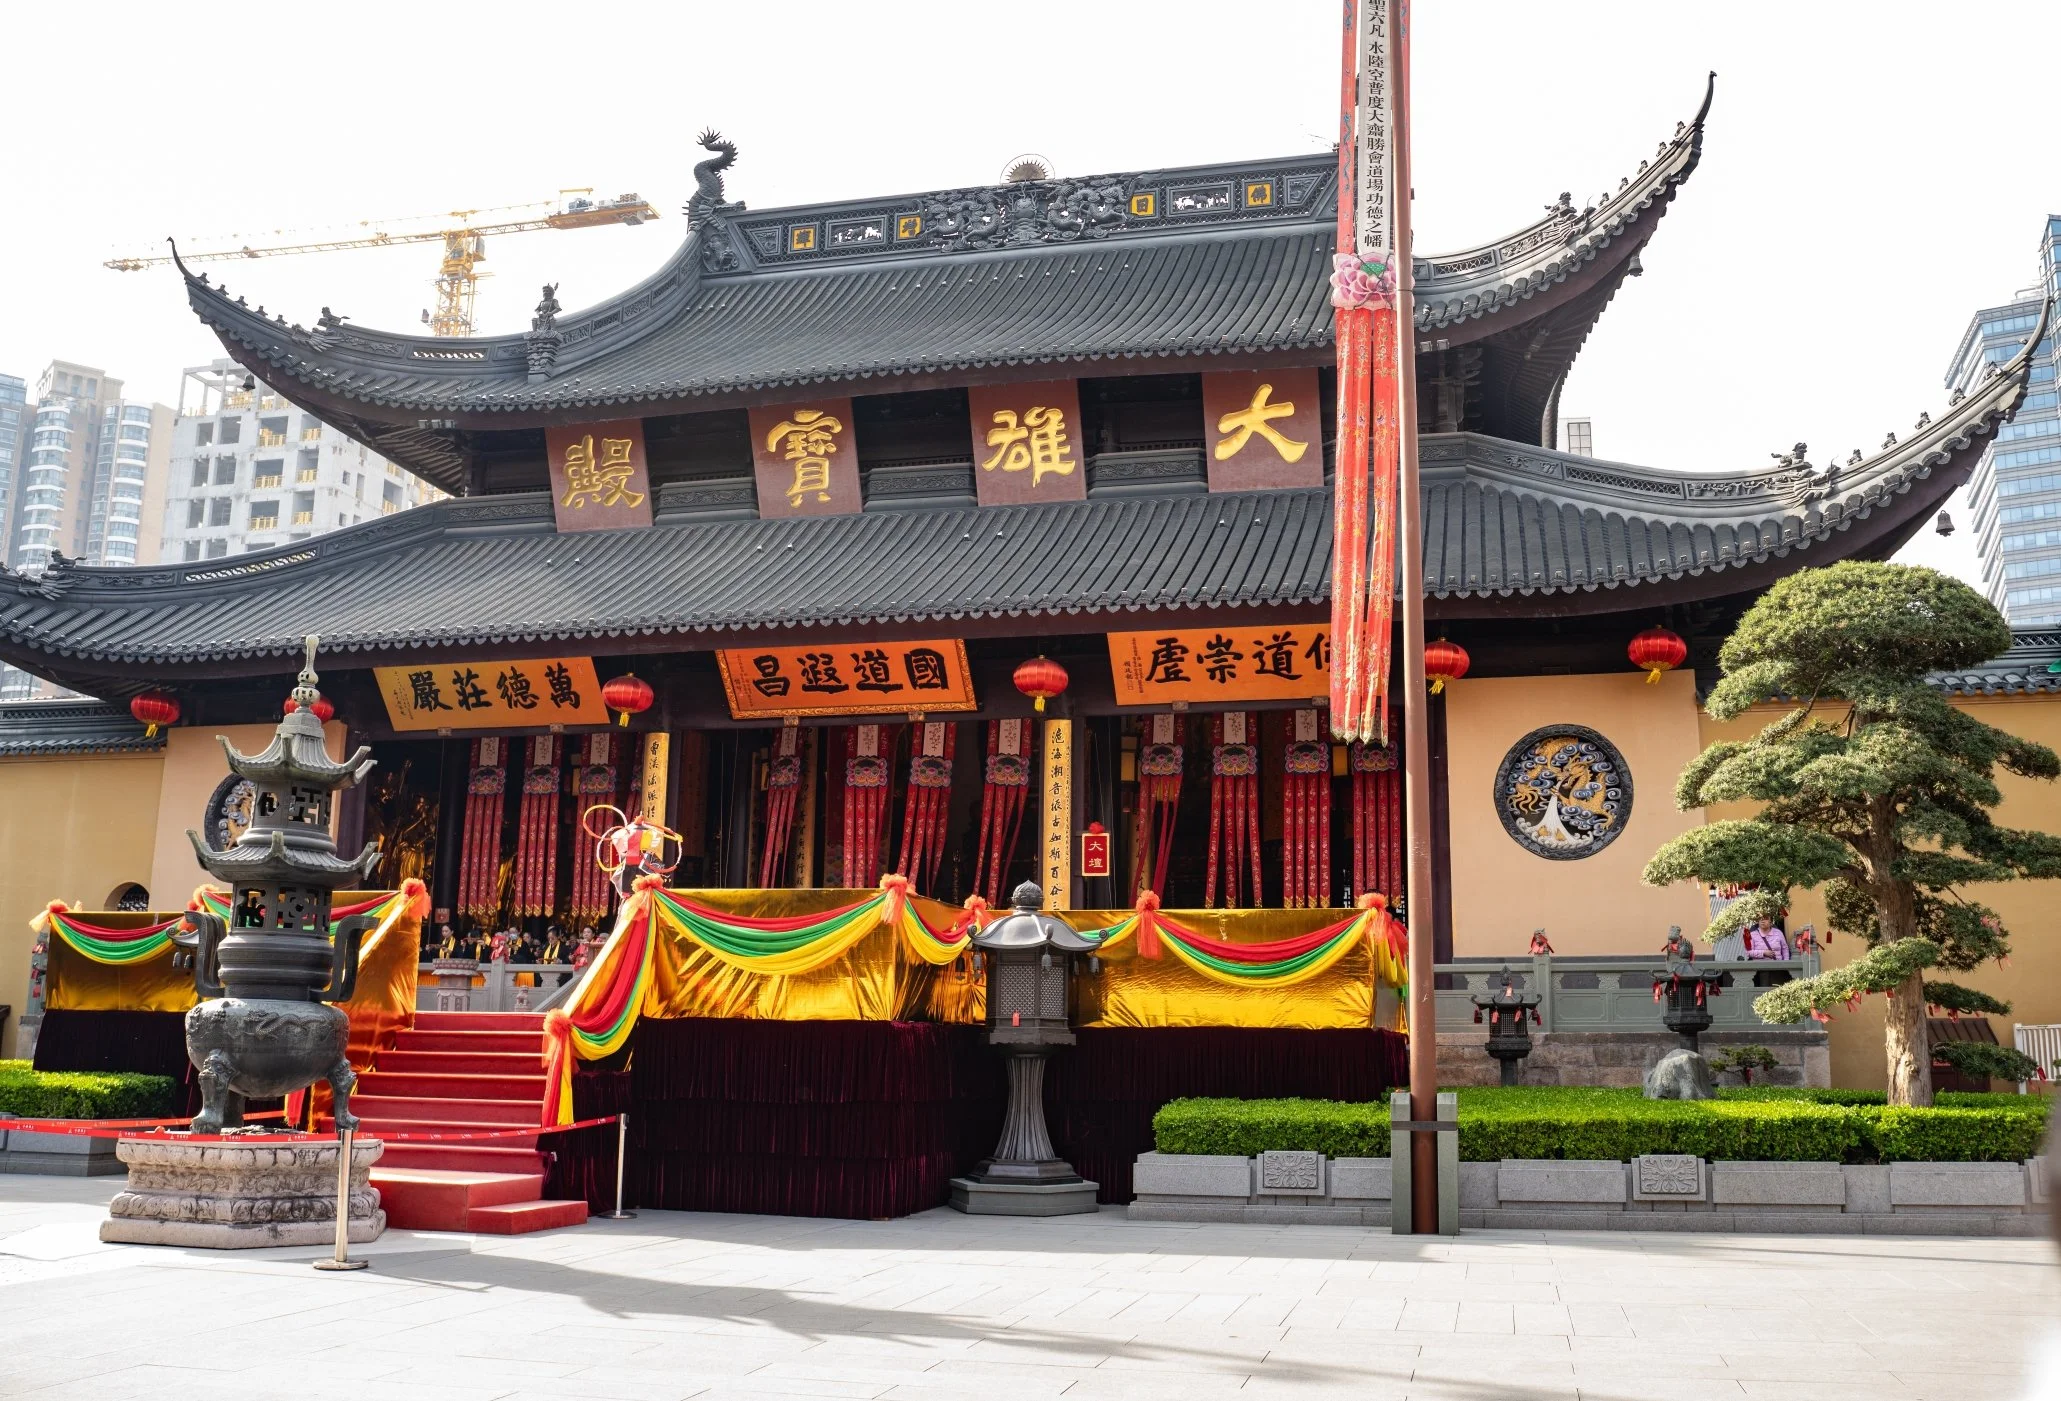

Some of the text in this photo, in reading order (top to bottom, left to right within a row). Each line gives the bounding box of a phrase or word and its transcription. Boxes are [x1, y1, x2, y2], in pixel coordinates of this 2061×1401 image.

[560, 383, 1309, 510] 大 雄 寶 殿
[1088, 840, 1104, 868] 大壇
